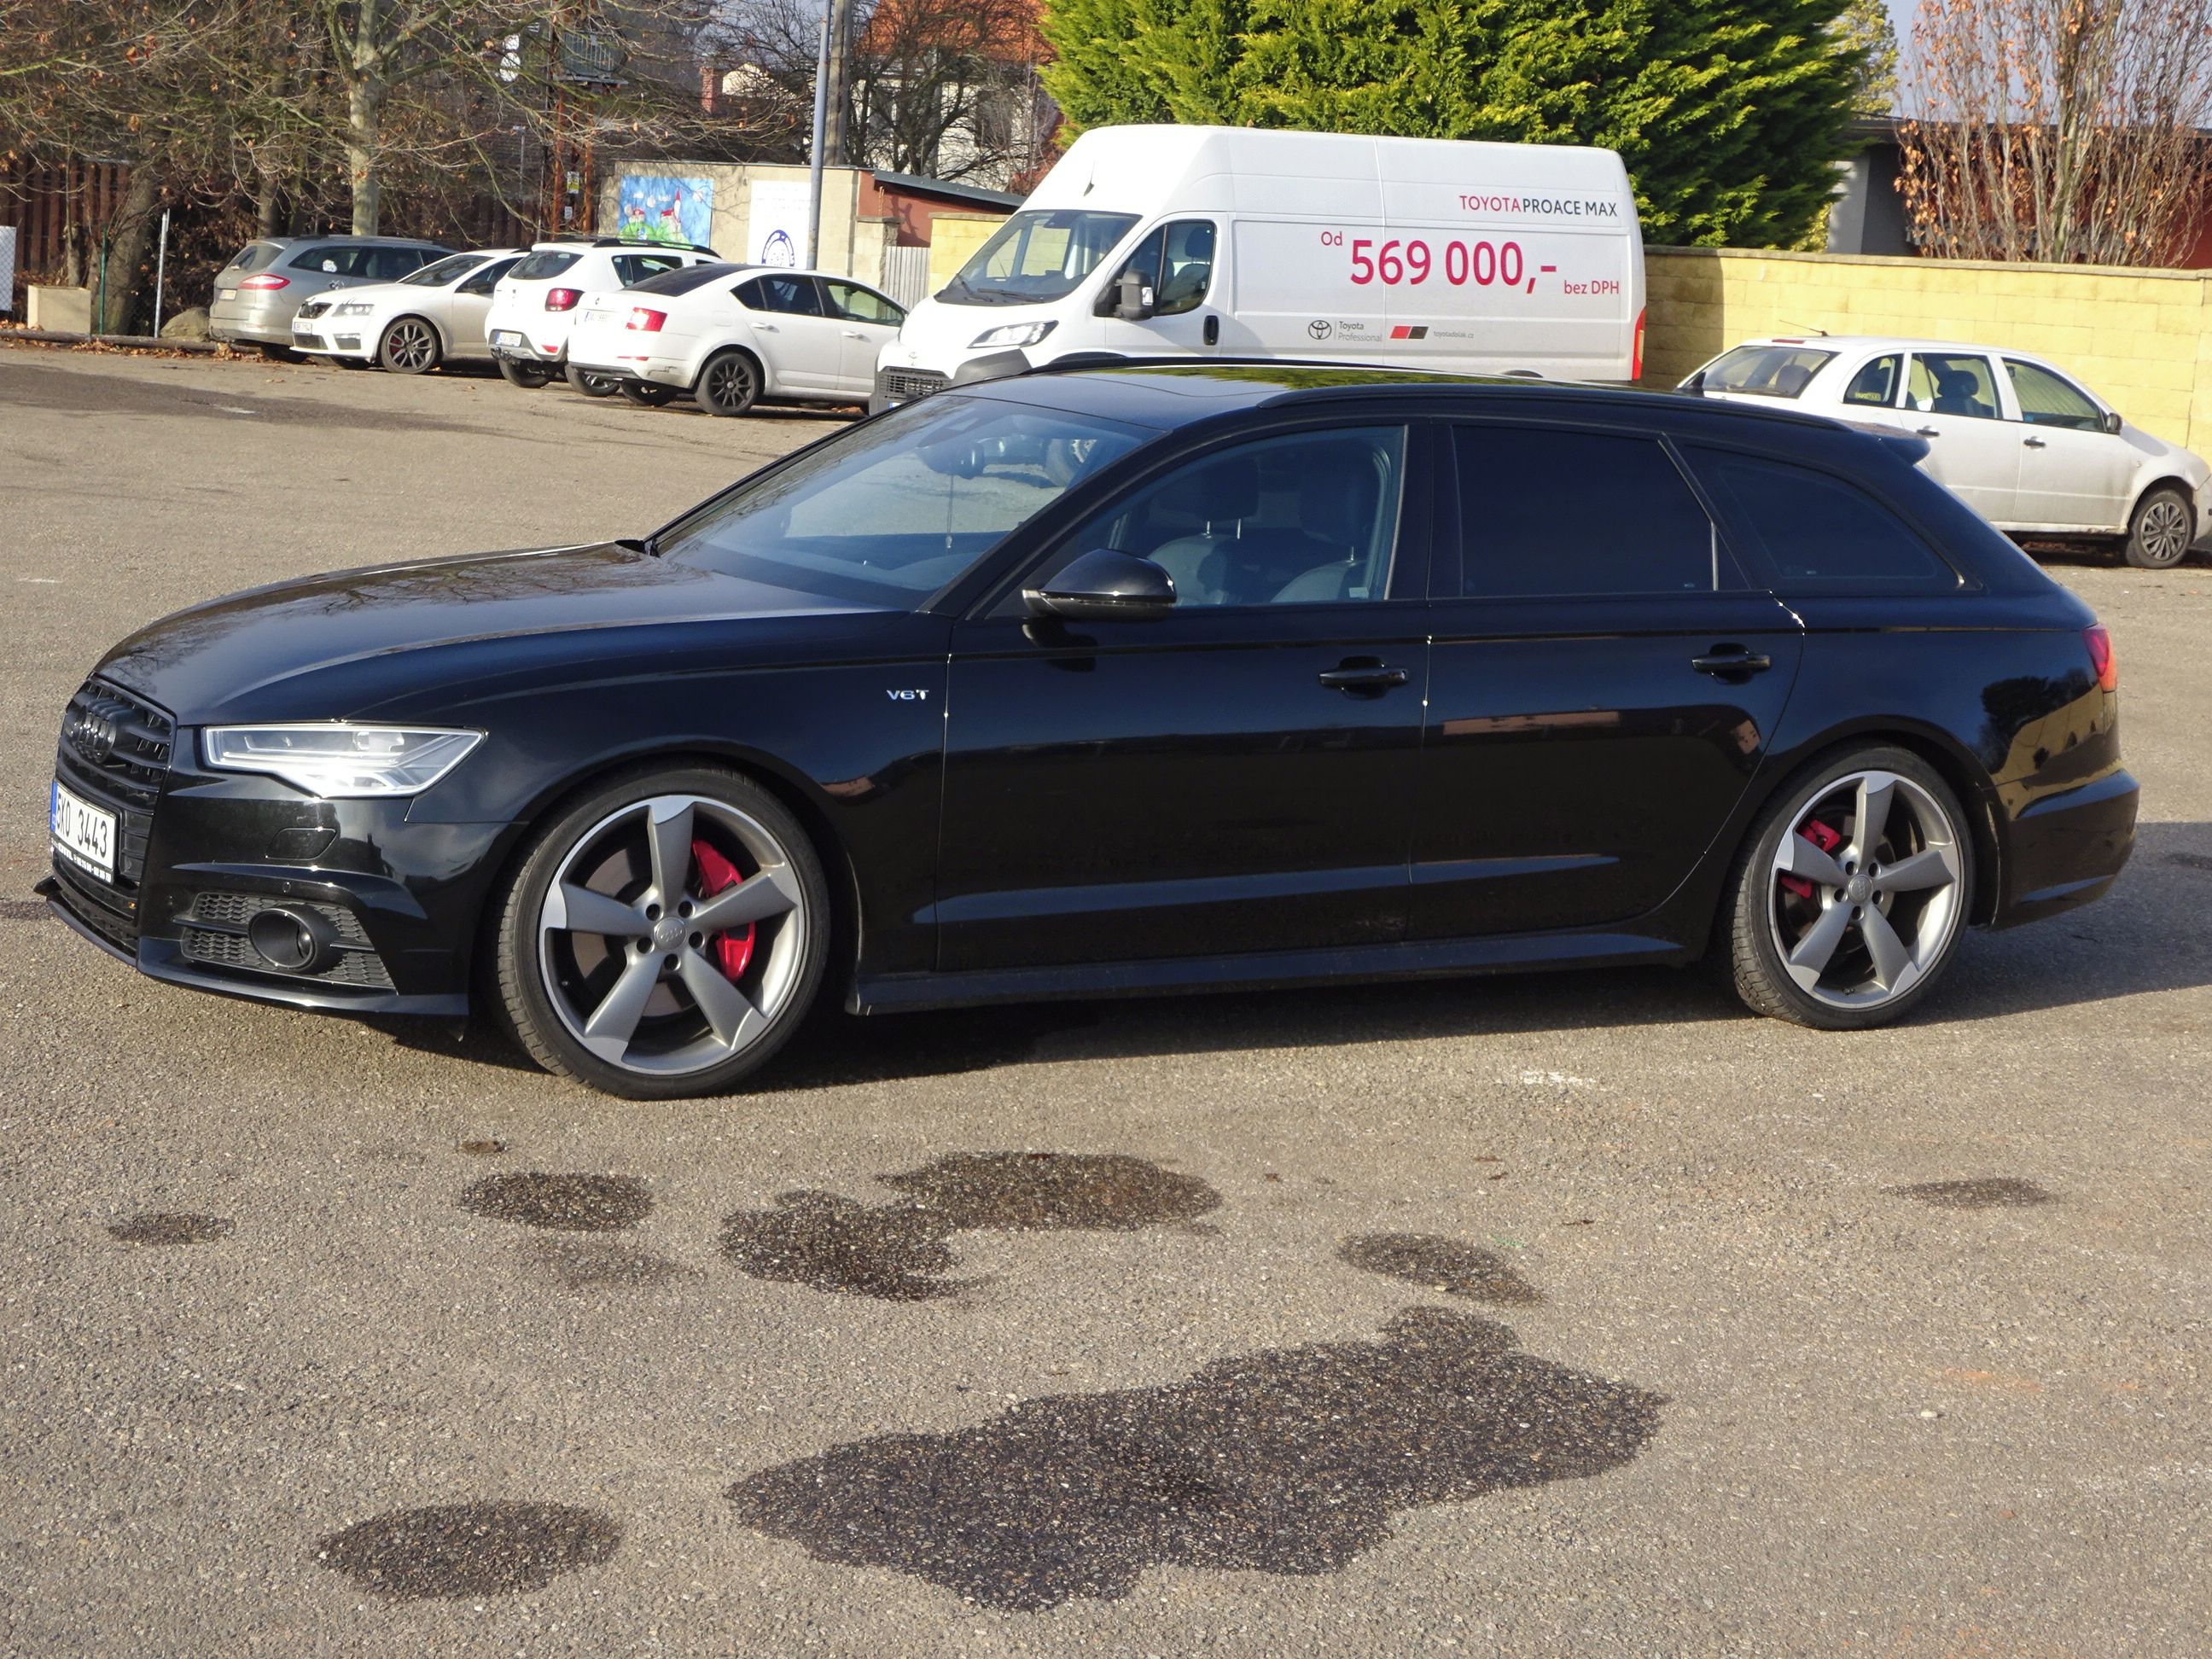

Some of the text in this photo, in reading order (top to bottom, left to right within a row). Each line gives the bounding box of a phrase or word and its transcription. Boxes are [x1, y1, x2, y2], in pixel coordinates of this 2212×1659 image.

[1585, 201, 1618, 217] MAX
[1320, 231, 1620, 294] Od 569 000,- bez DPH
[1339, 321, 1365, 332] Toyota
[1338, 332, 1382, 342] Professional
[887, 690, 929, 700] V6T
[78, 808, 108, 859] 3443
